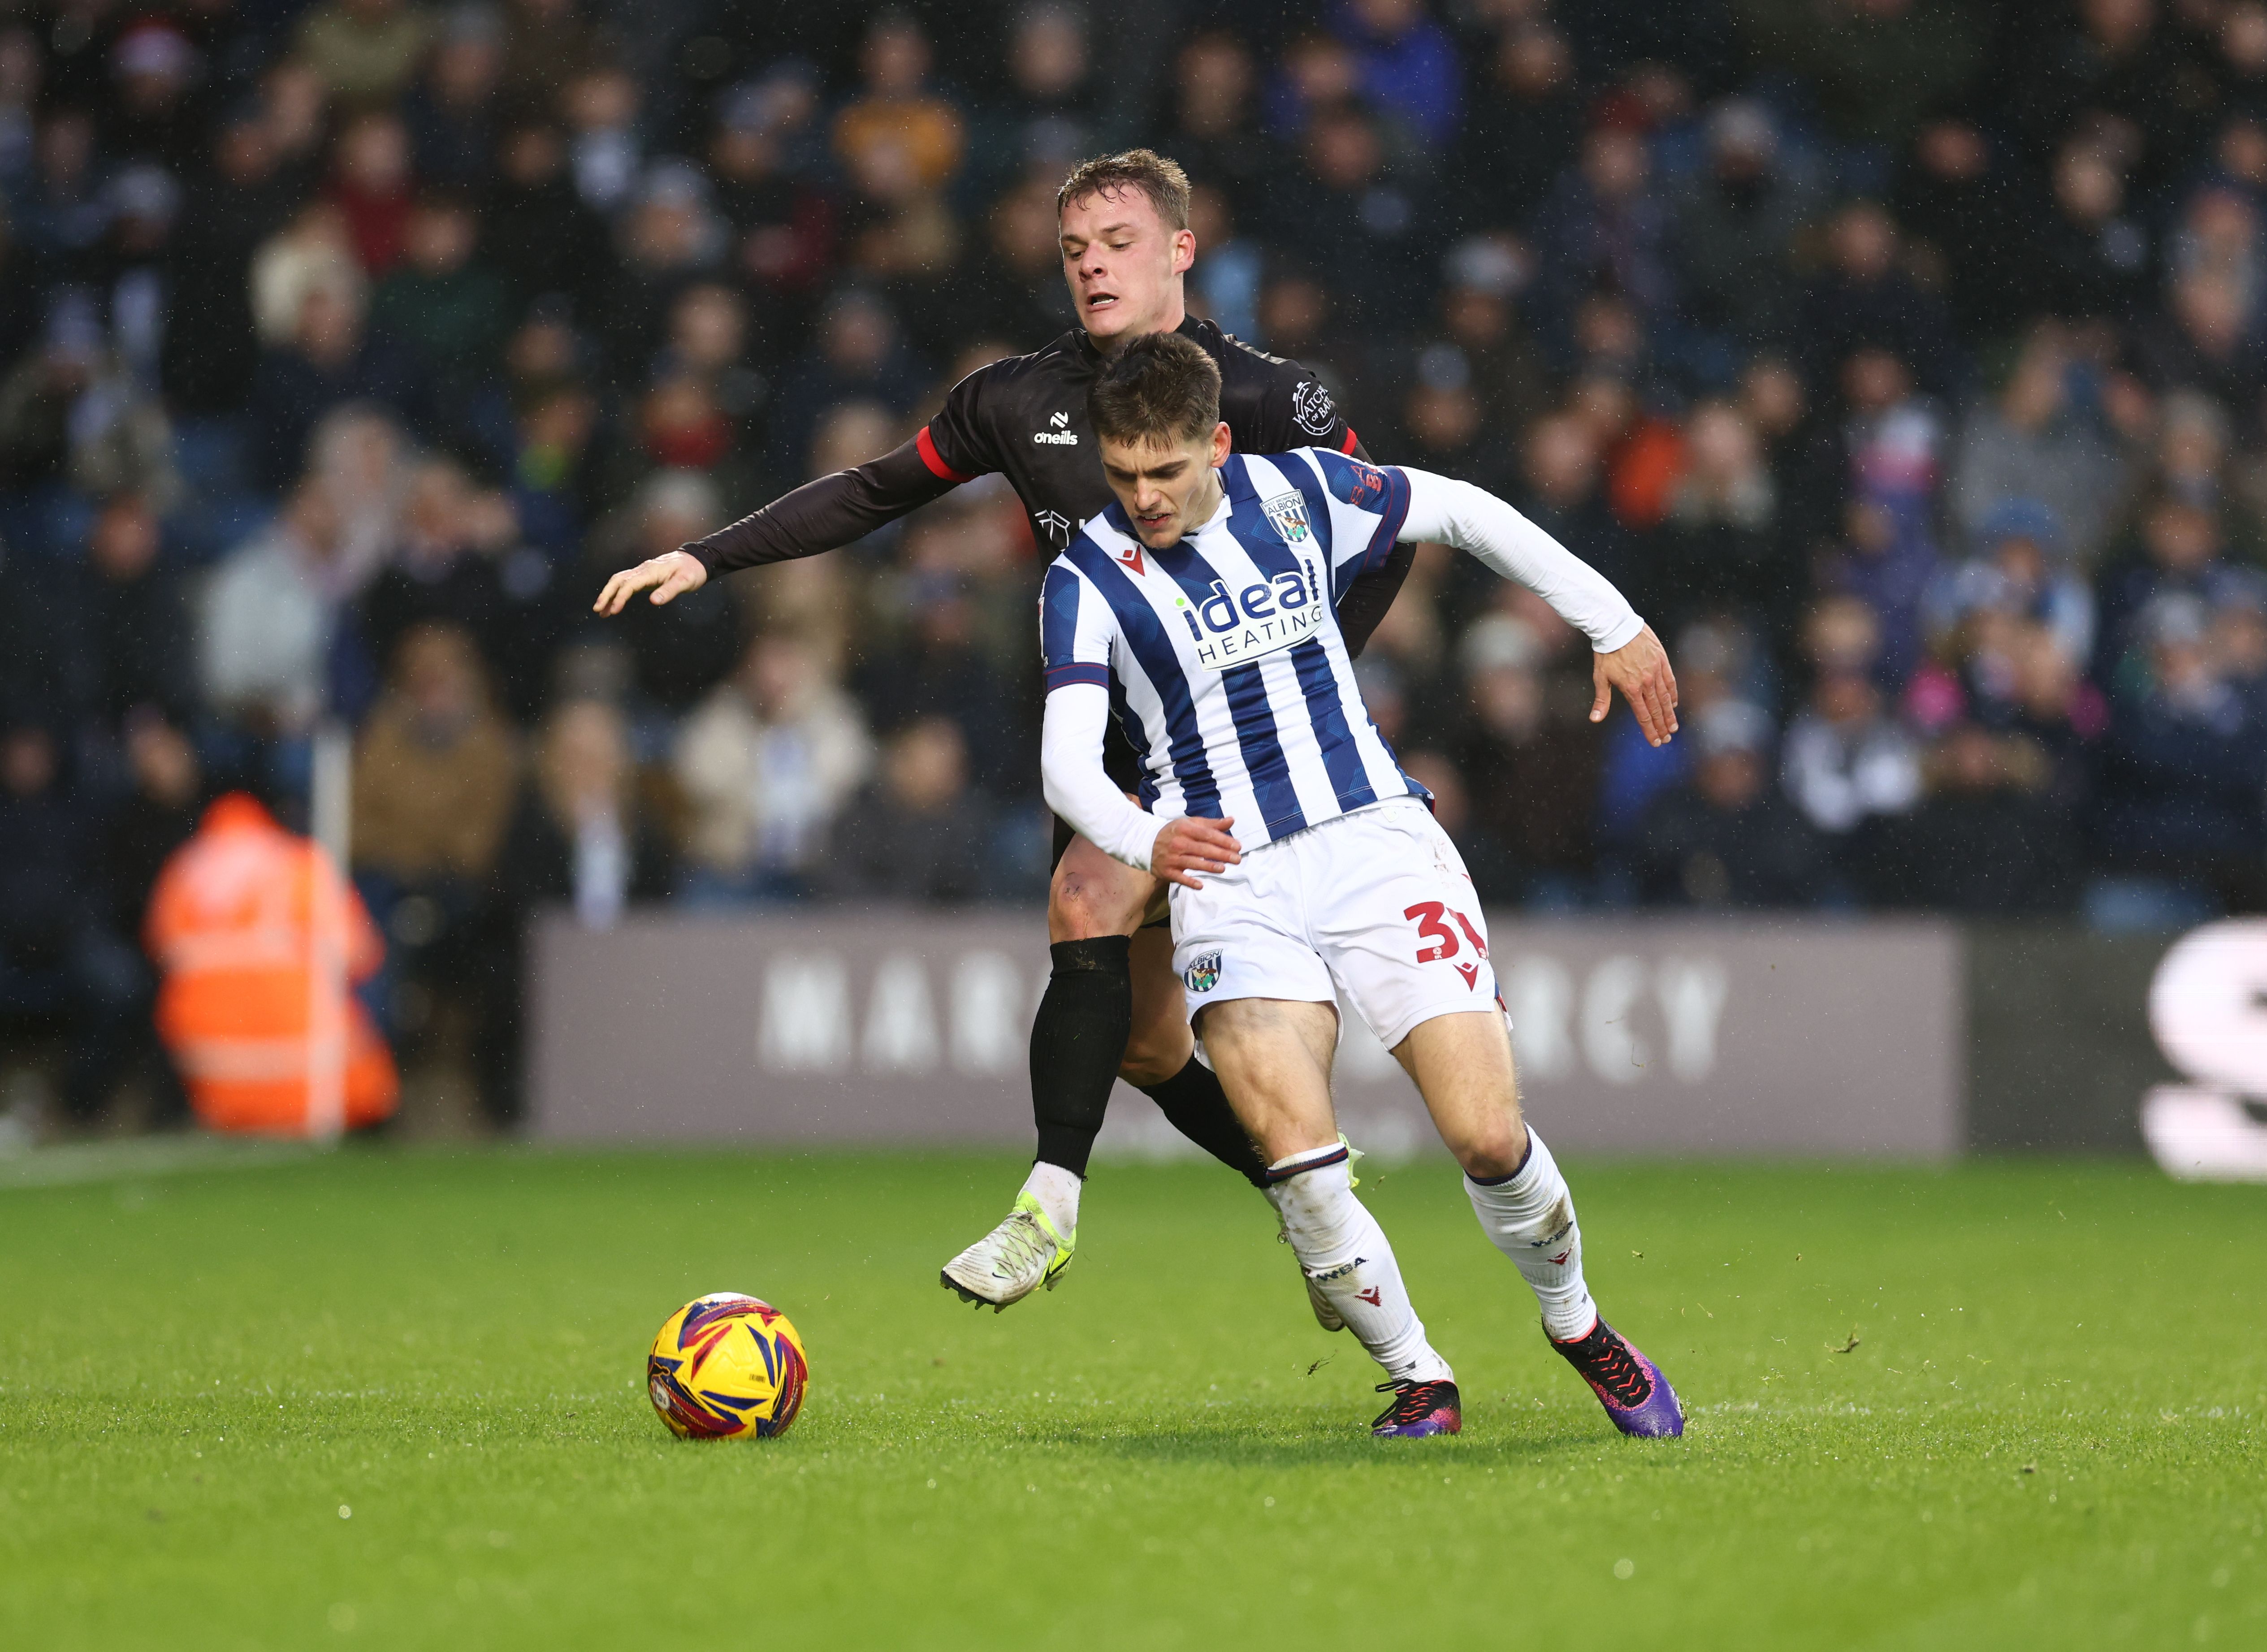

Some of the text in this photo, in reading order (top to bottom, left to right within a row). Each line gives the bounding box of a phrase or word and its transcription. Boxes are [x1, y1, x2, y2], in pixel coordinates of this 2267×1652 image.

[1311, 412, 1319, 422] OF
[1268, 497, 1302, 515] ALBION
[1276, 493, 1299, 503] BROMWICH
[1176, 558, 1319, 642] ideal
[1198, 605, 1323, 664] HEATING
[1403, 901, 1488, 964] 31
[1187, 951, 1220, 972] ALBION
[758, 945, 1051, 1075] MAR
